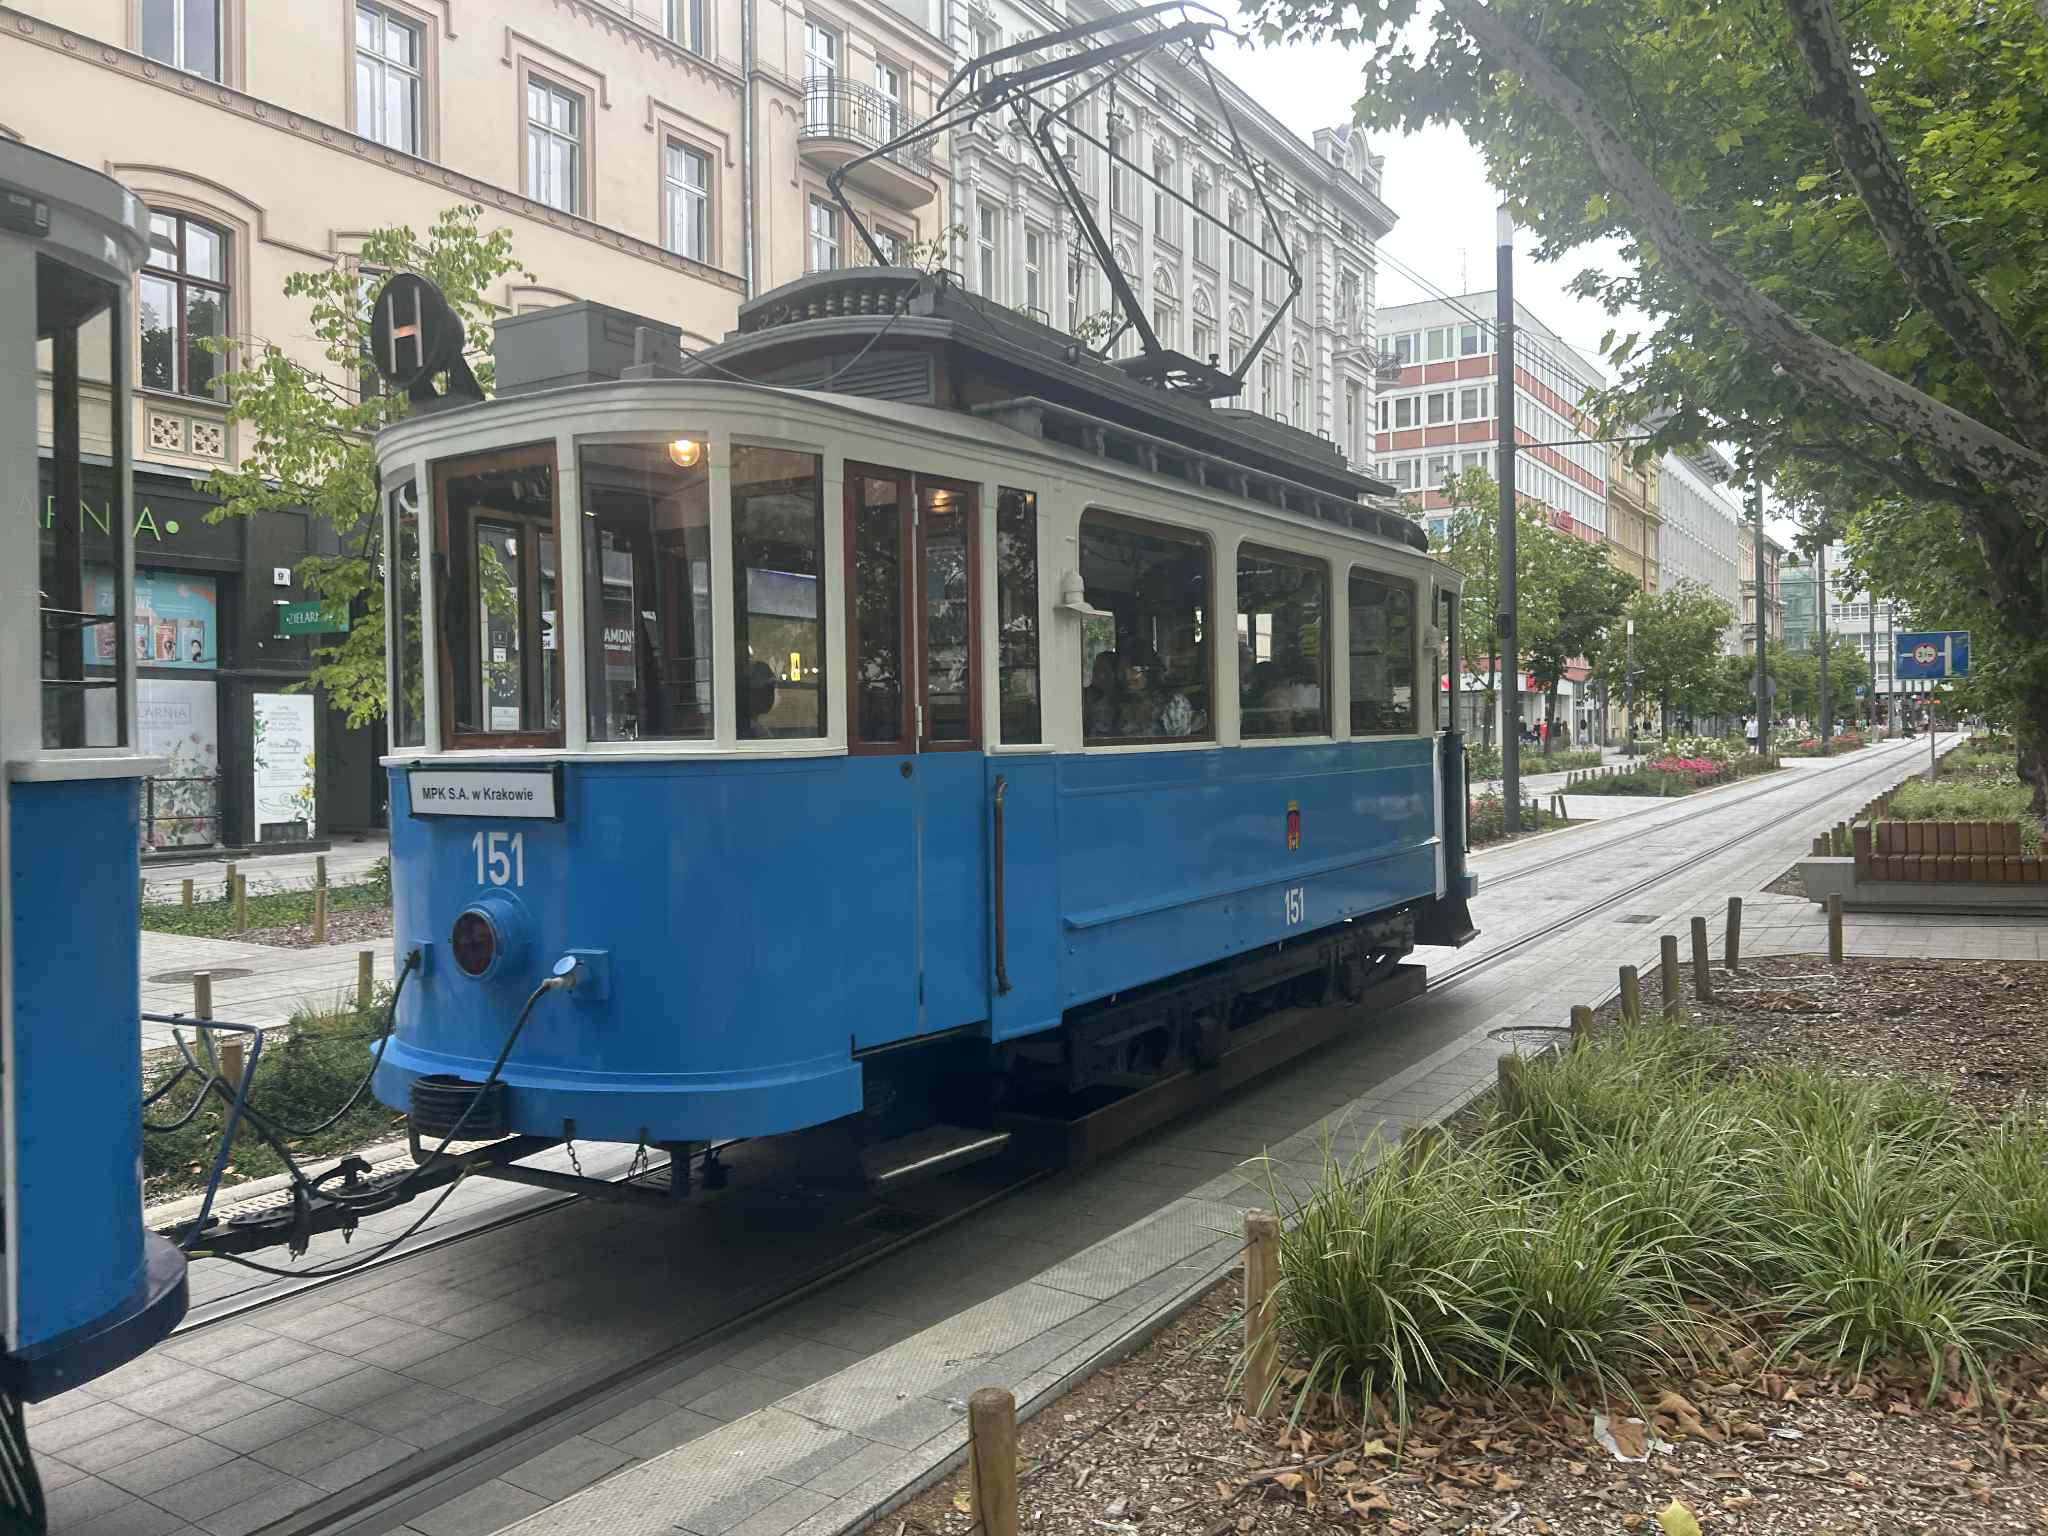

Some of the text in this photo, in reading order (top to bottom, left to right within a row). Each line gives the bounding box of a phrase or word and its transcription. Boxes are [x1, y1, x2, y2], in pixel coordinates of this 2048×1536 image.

[387, 286, 423, 374] H
[422, 787, 534, 801] MPK S.A. w Krakowie
[472, 831, 525, 887] 151
[1285, 887, 1304, 925] 151
